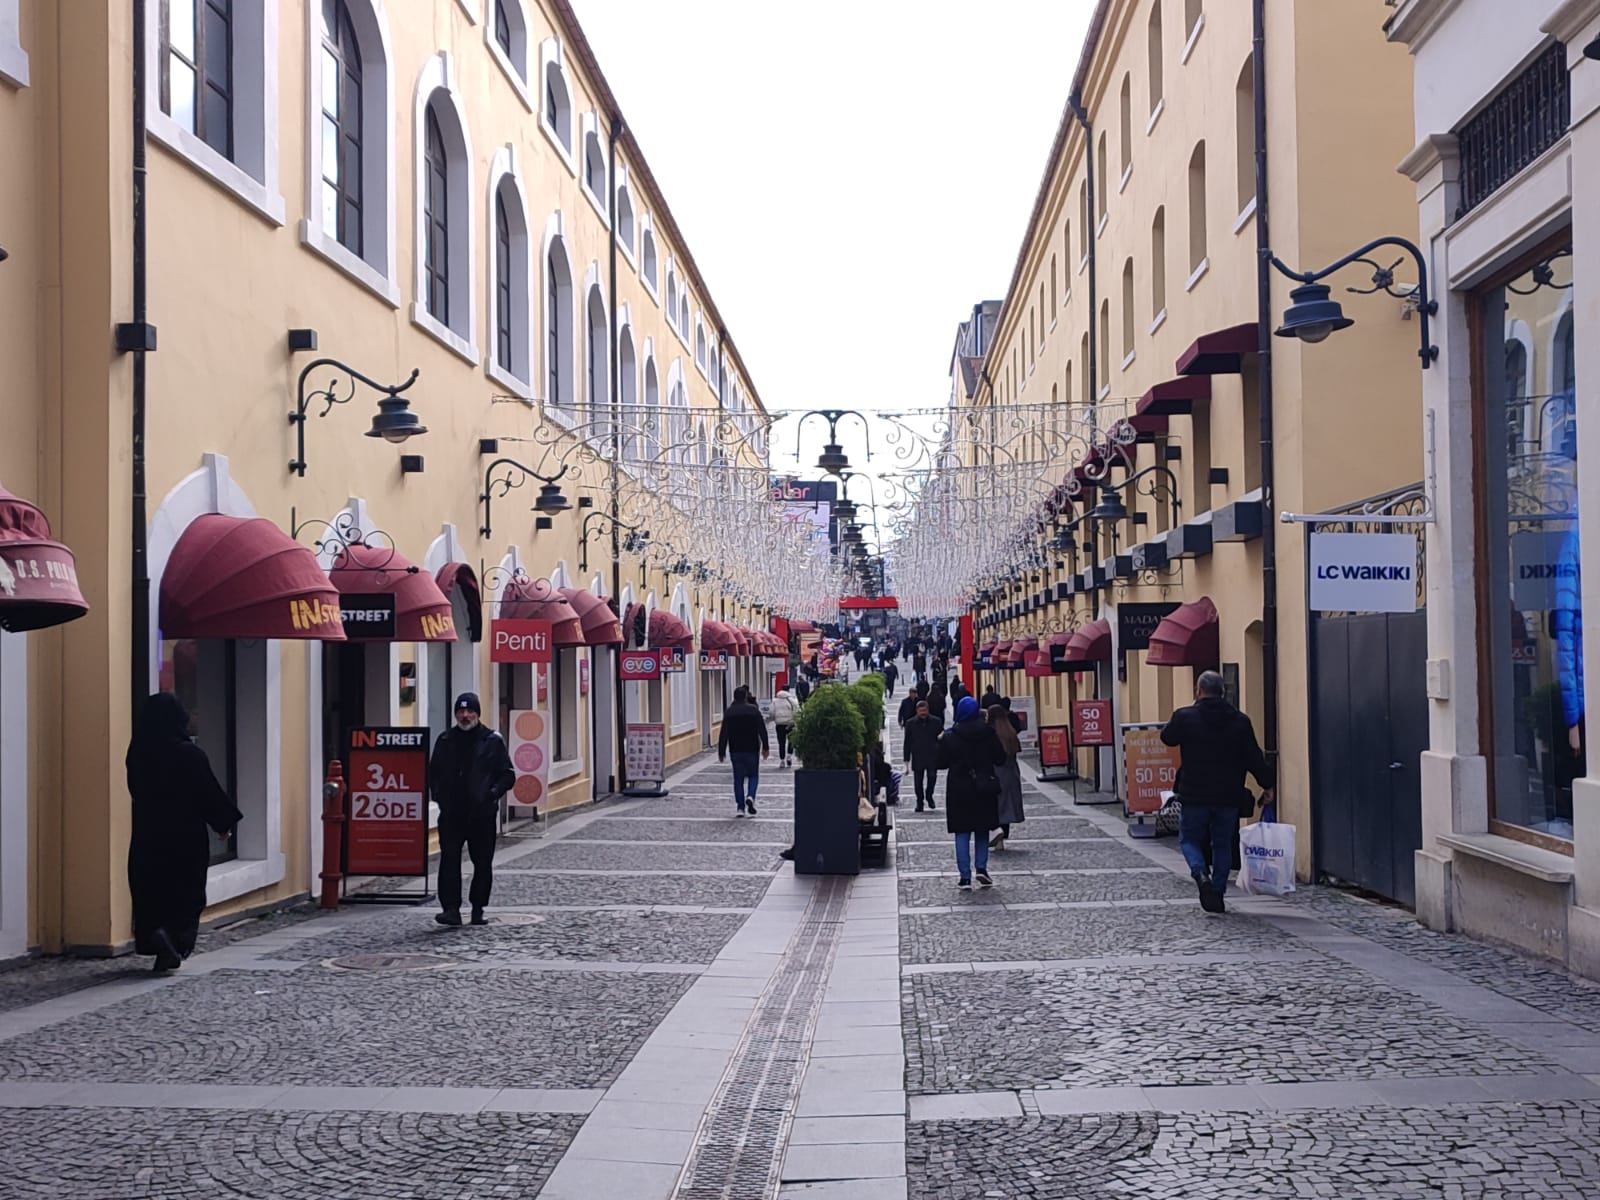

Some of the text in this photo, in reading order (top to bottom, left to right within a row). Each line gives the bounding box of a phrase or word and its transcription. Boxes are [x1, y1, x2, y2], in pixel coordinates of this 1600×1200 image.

[15, 559, 45, 578] U.S.
[1317, 565, 1339, 579] LC
[1133, 628, 1152, 637] CO
[495, 631, 546, 651] Penti
[624, 658, 655, 672] eve
[385, 773, 410, 789] AL
[373, 798, 417, 818] ÖDE
